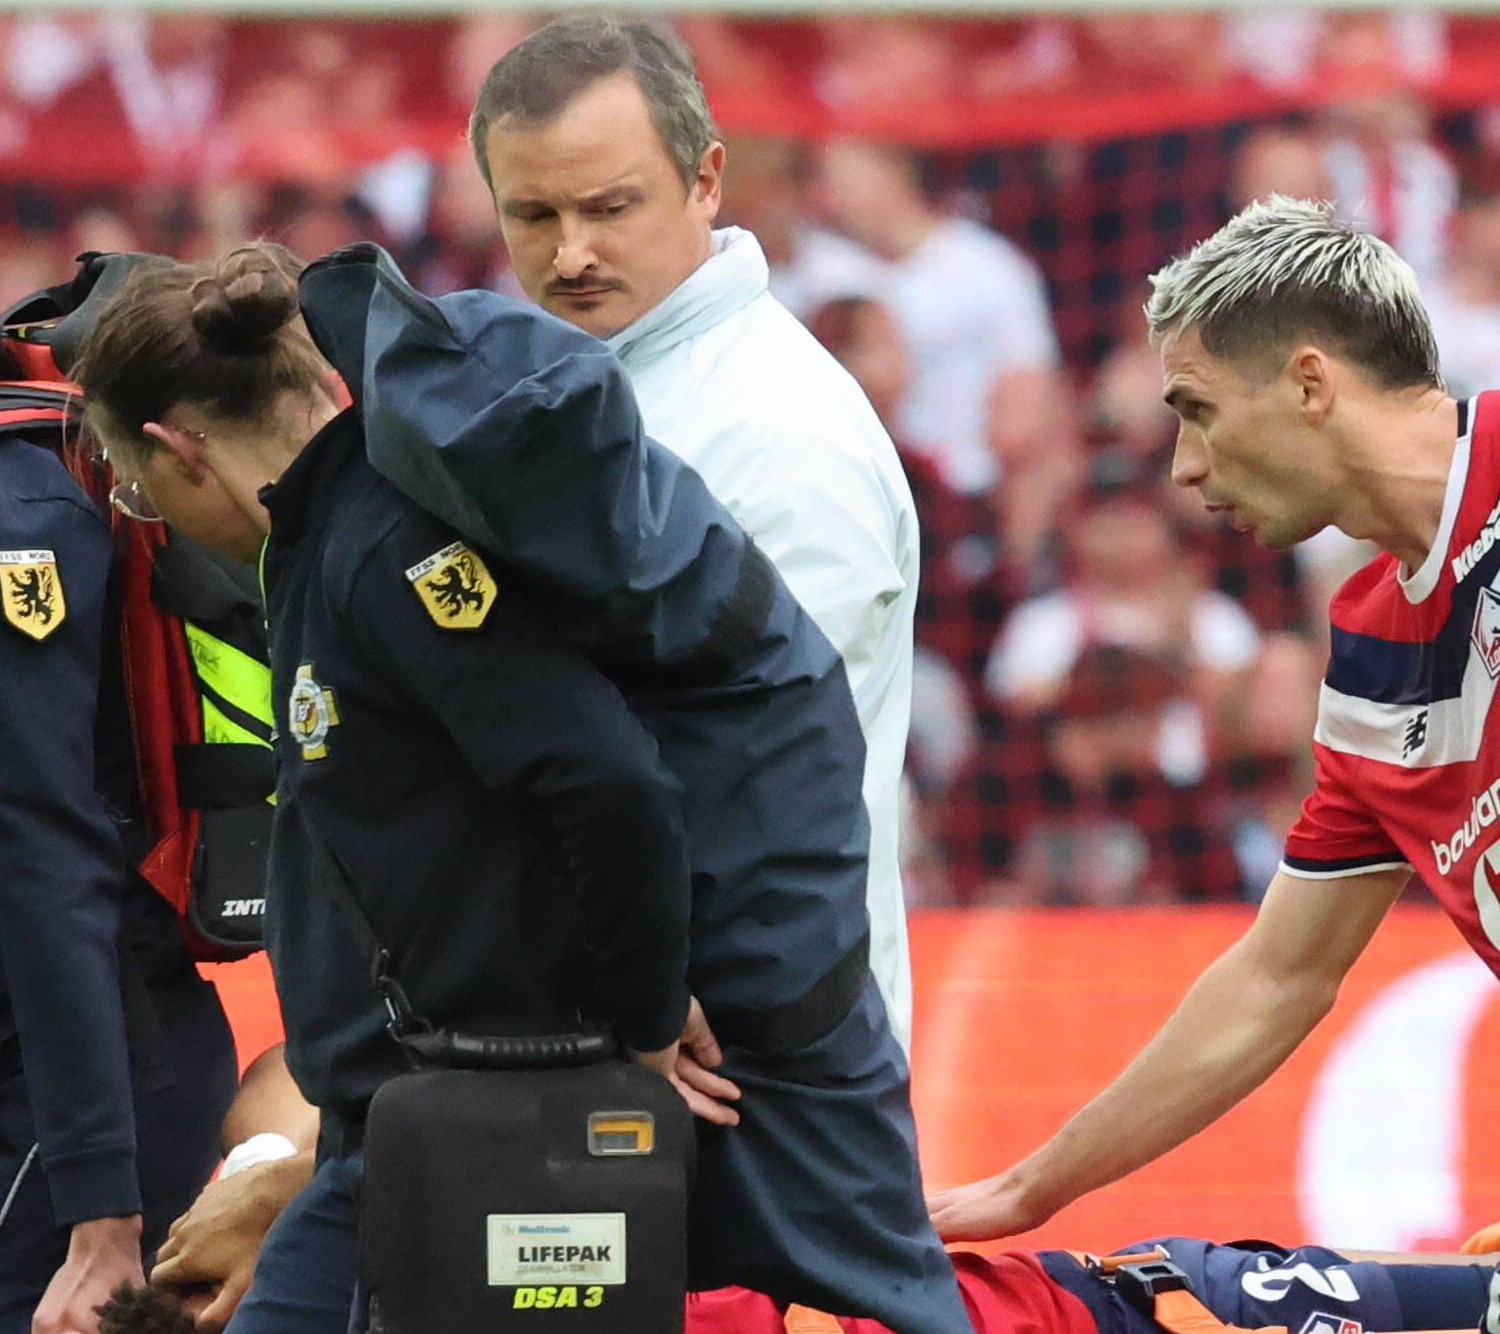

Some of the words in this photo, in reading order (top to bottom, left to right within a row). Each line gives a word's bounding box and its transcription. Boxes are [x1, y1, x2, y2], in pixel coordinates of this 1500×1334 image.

[518, 1245, 611, 1262] LIFEPAK
[513, 1287, 578, 1309] DSA
[583, 1286, 604, 1308] 3
